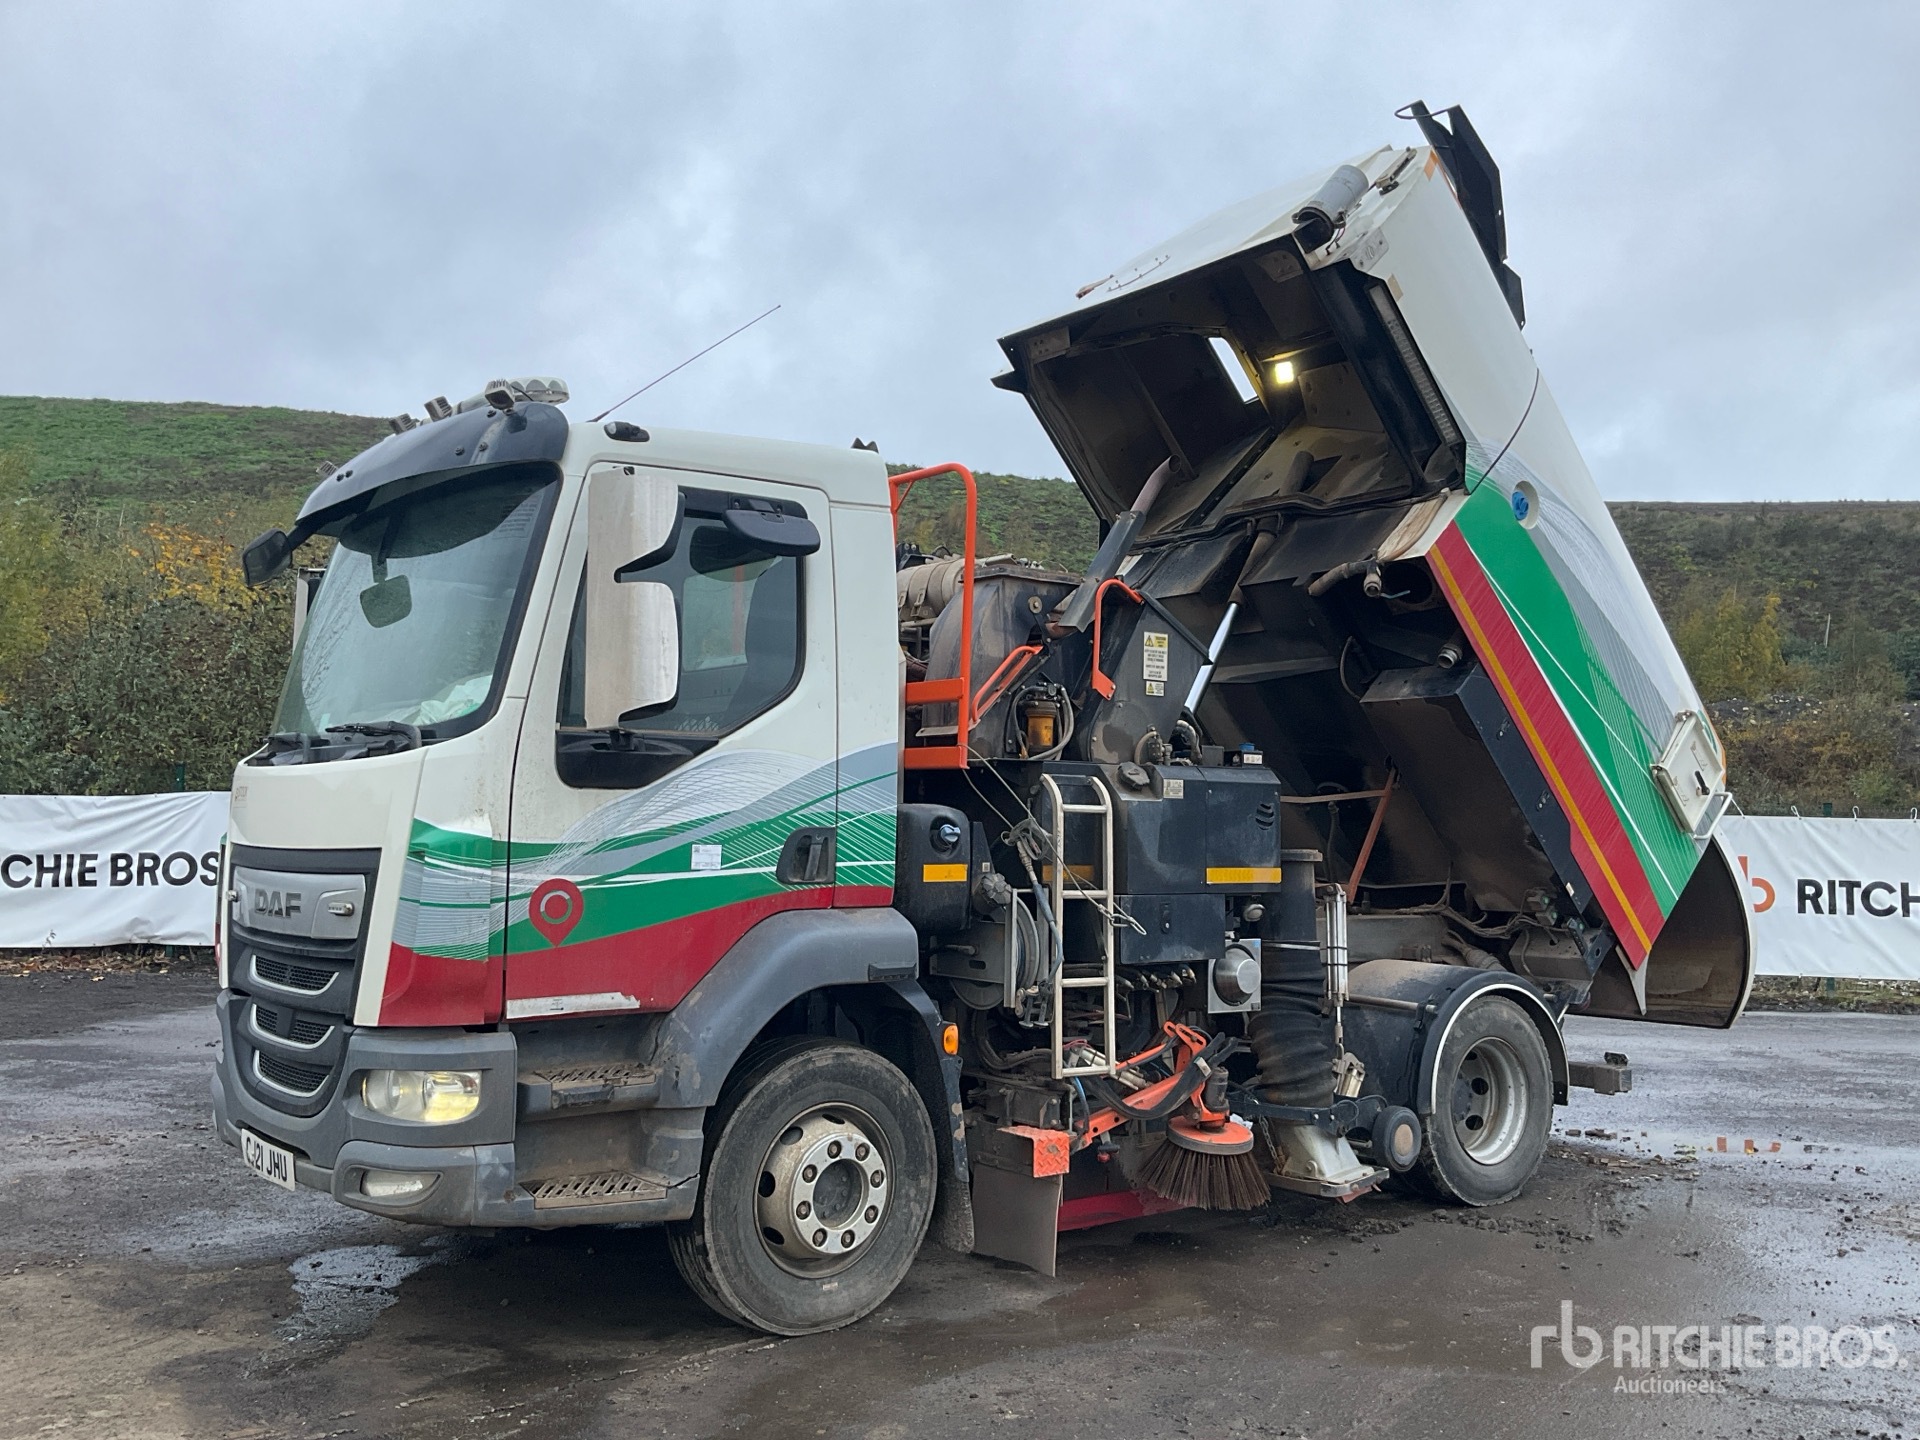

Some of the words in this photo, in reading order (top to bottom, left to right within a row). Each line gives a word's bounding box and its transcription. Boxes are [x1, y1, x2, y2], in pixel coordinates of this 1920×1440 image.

[0, 853, 98, 888] CHIE
[109, 851, 219, 888] BROS
[254, 888, 302, 919] DAF
[1797, 878, 1920, 918] RITCH
[266, 1149, 288, 1182] JHU
